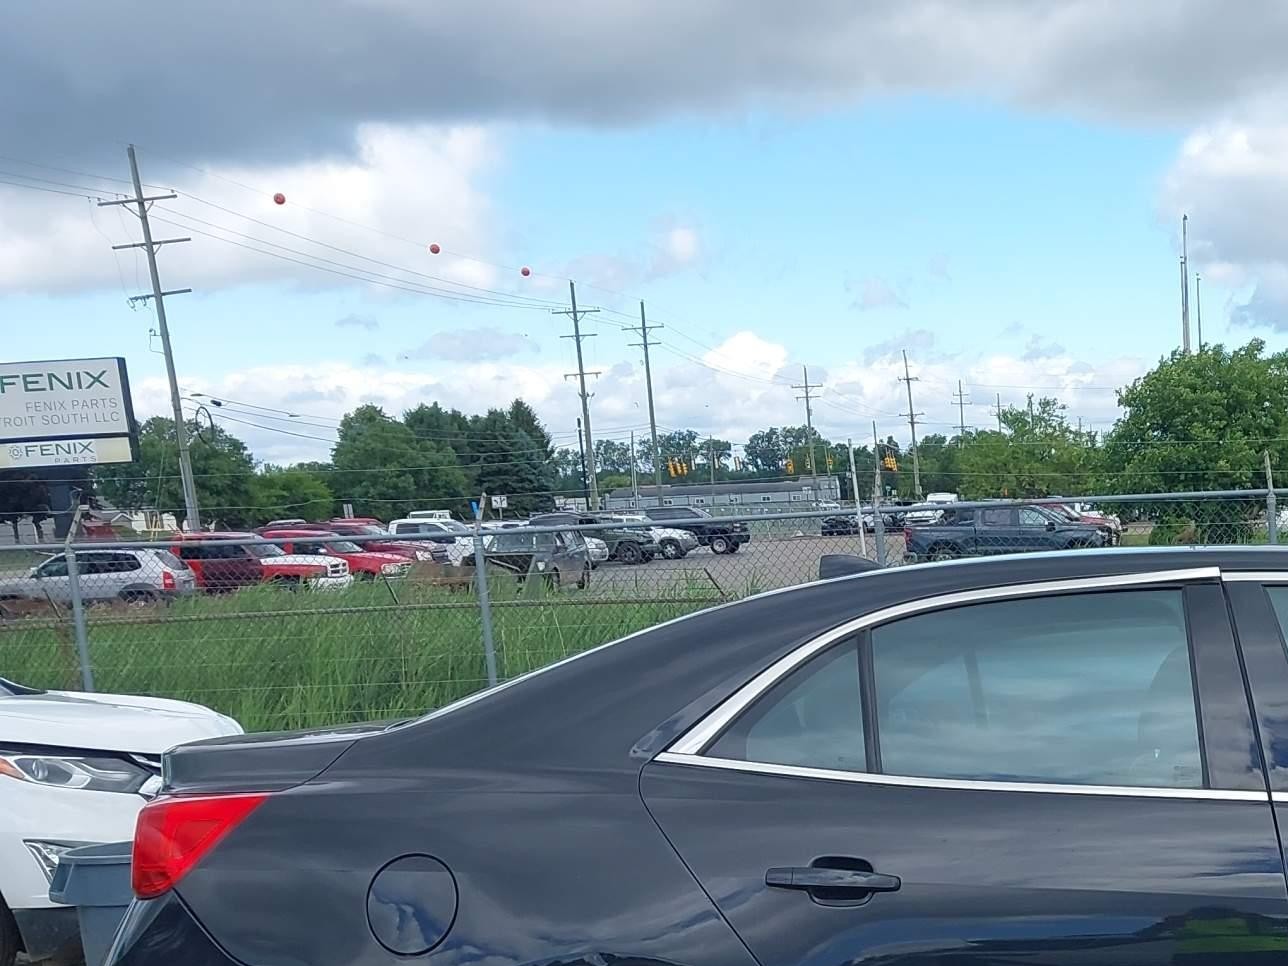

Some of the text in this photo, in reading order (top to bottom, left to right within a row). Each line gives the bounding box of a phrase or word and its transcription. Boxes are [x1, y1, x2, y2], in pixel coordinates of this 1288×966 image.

[0, 370, 110, 394] FENIX
[25, 398, 118, 412] FENIX PARTS
[41, 413, 90, 426] SOUTH
[94, 411, 121, 423] LLC
[25, 441, 95, 457] FENIX
